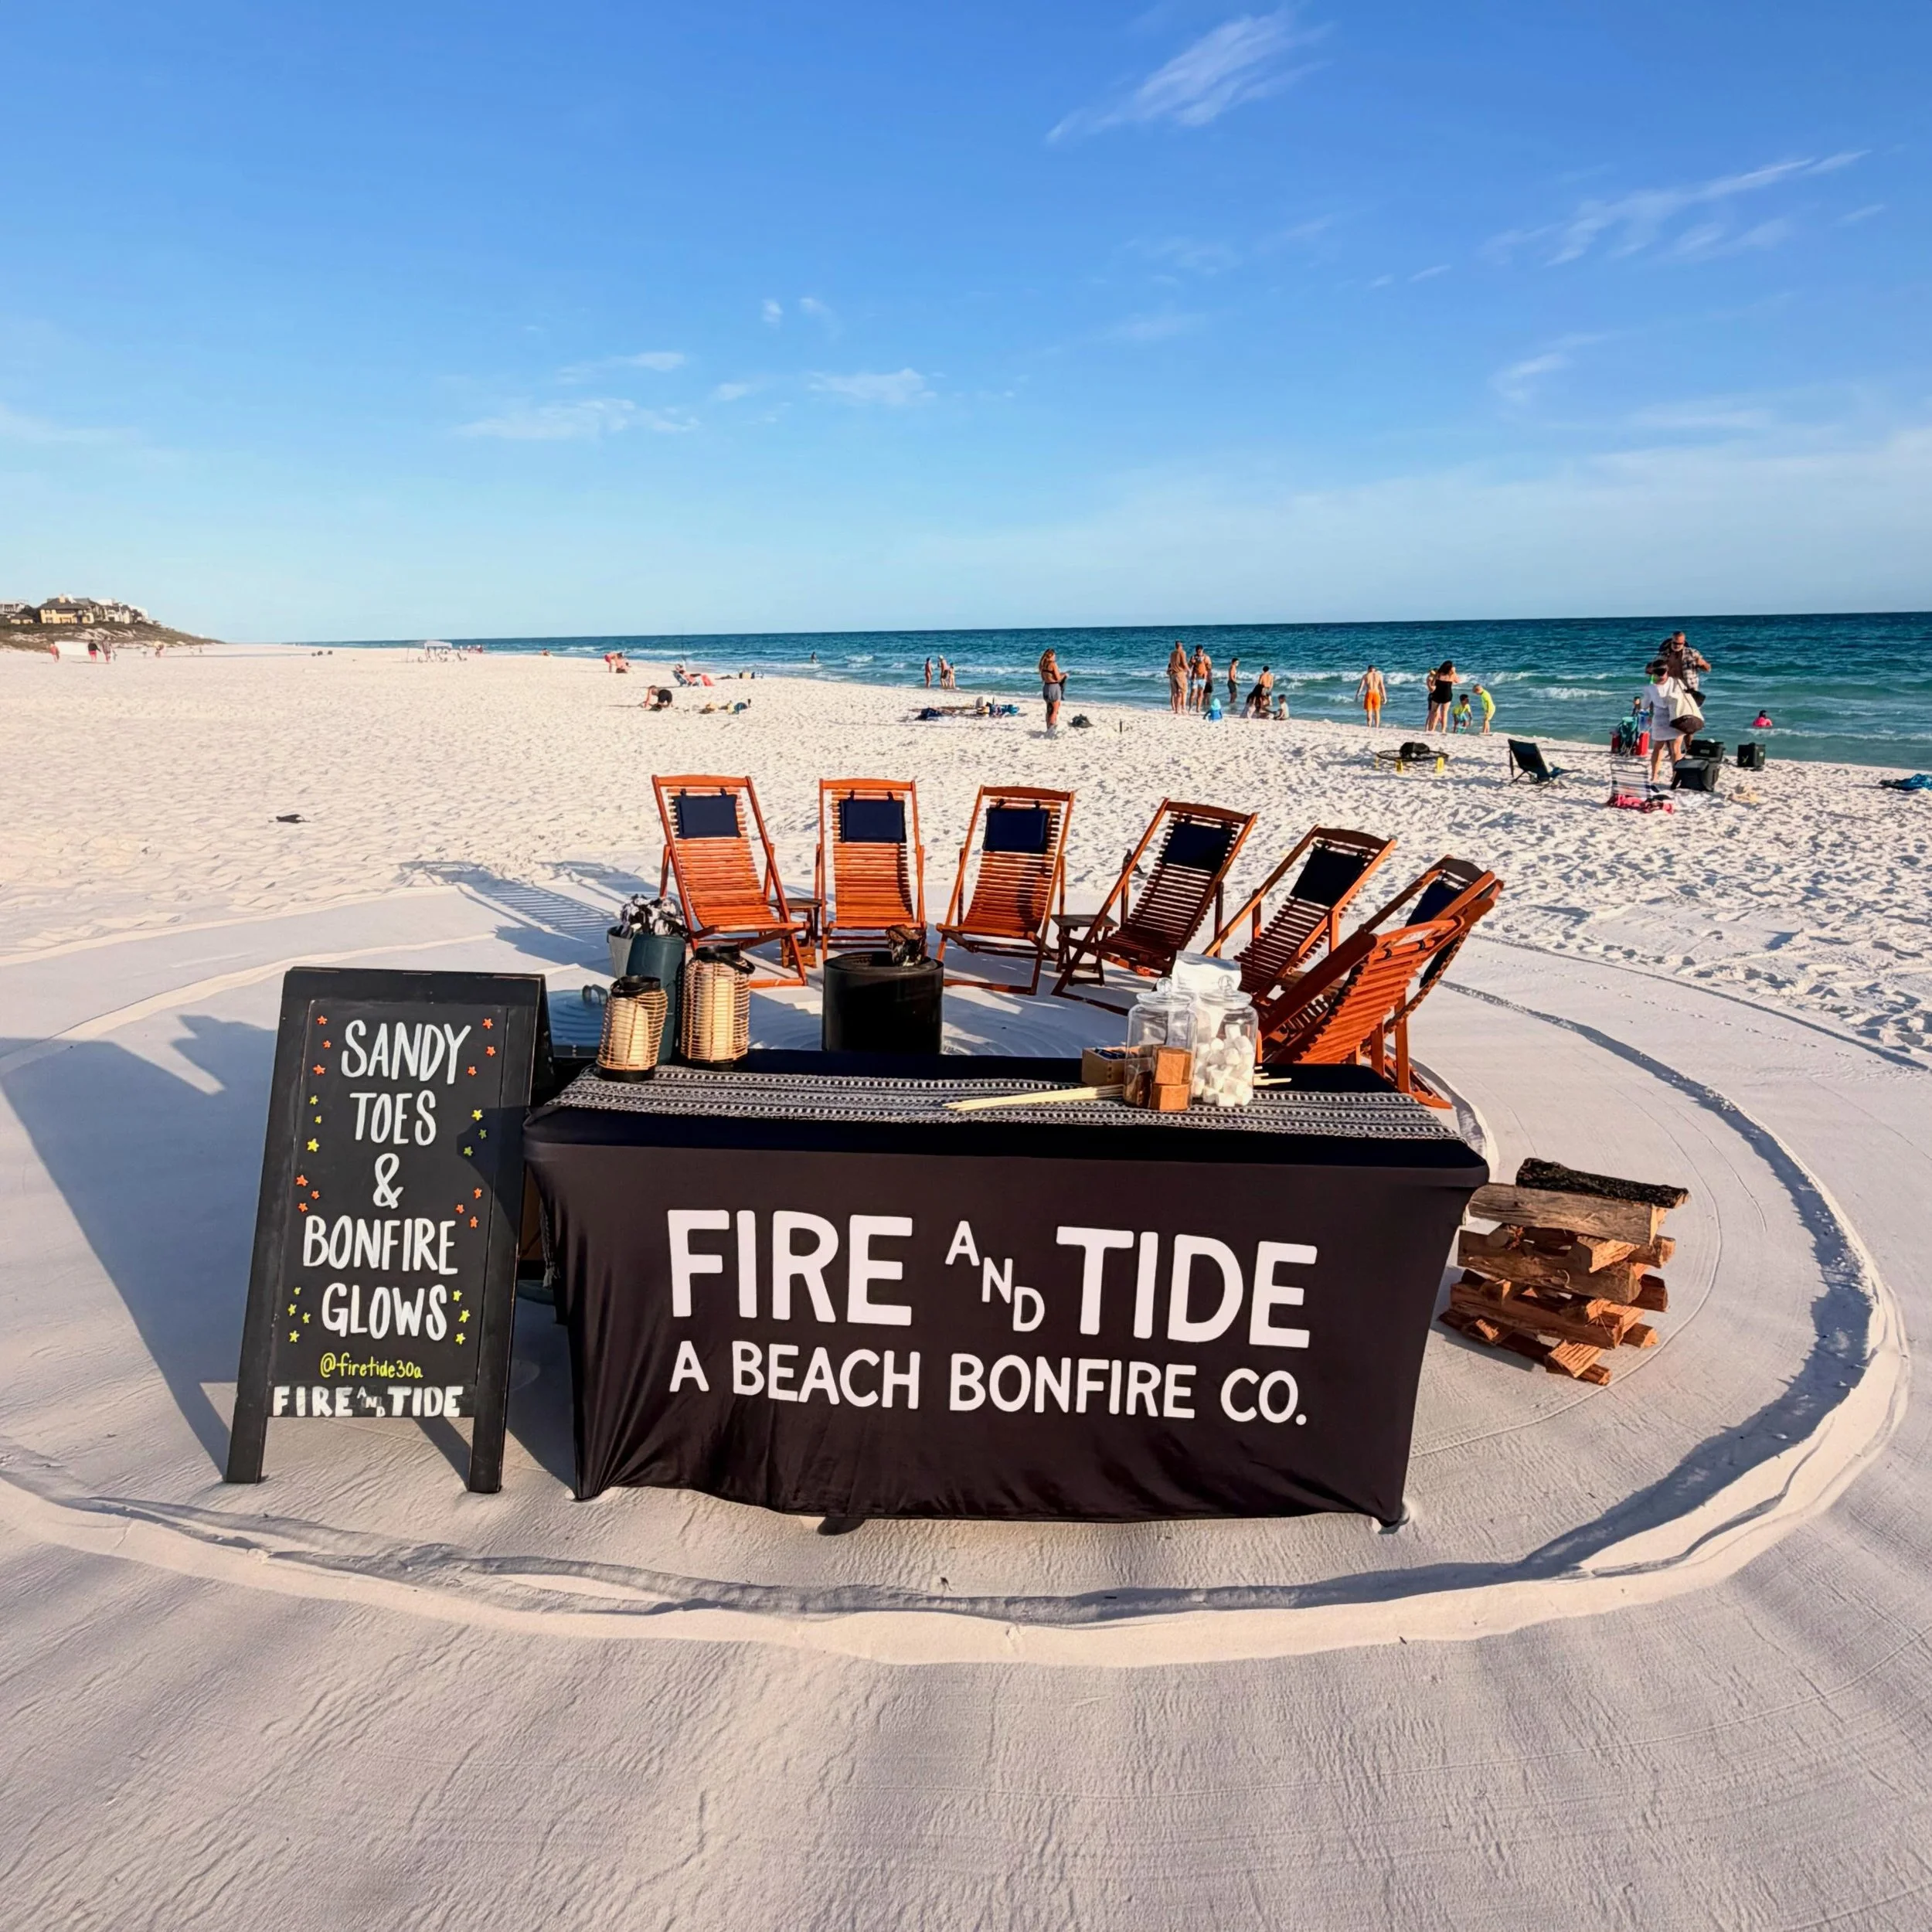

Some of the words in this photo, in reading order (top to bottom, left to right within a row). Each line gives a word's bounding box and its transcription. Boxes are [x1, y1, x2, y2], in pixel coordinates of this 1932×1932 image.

[342, 1020, 471, 1084] SANDY
[350, 1090, 436, 1145] TOES
[373, 1153, 403, 1209] &
[303, 1216, 457, 1274] BONFIRE
[668, 1210, 912, 1325] FIRE
[1056, 1226, 1317, 1348] TIDE
[321, 1283, 447, 1341] GLOWS
[321, 1352, 423, 1379] @firetide30a
[670, 1341, 709, 1392] A
[733, 1341, 920, 1409] BEACH
[950, 1354, 1196, 1418] BONFIRE
[1221, 1369, 1306, 1425] CO.
[273, 1386, 353, 1417] FIRE
[387, 1386, 463, 1417] TIDE
